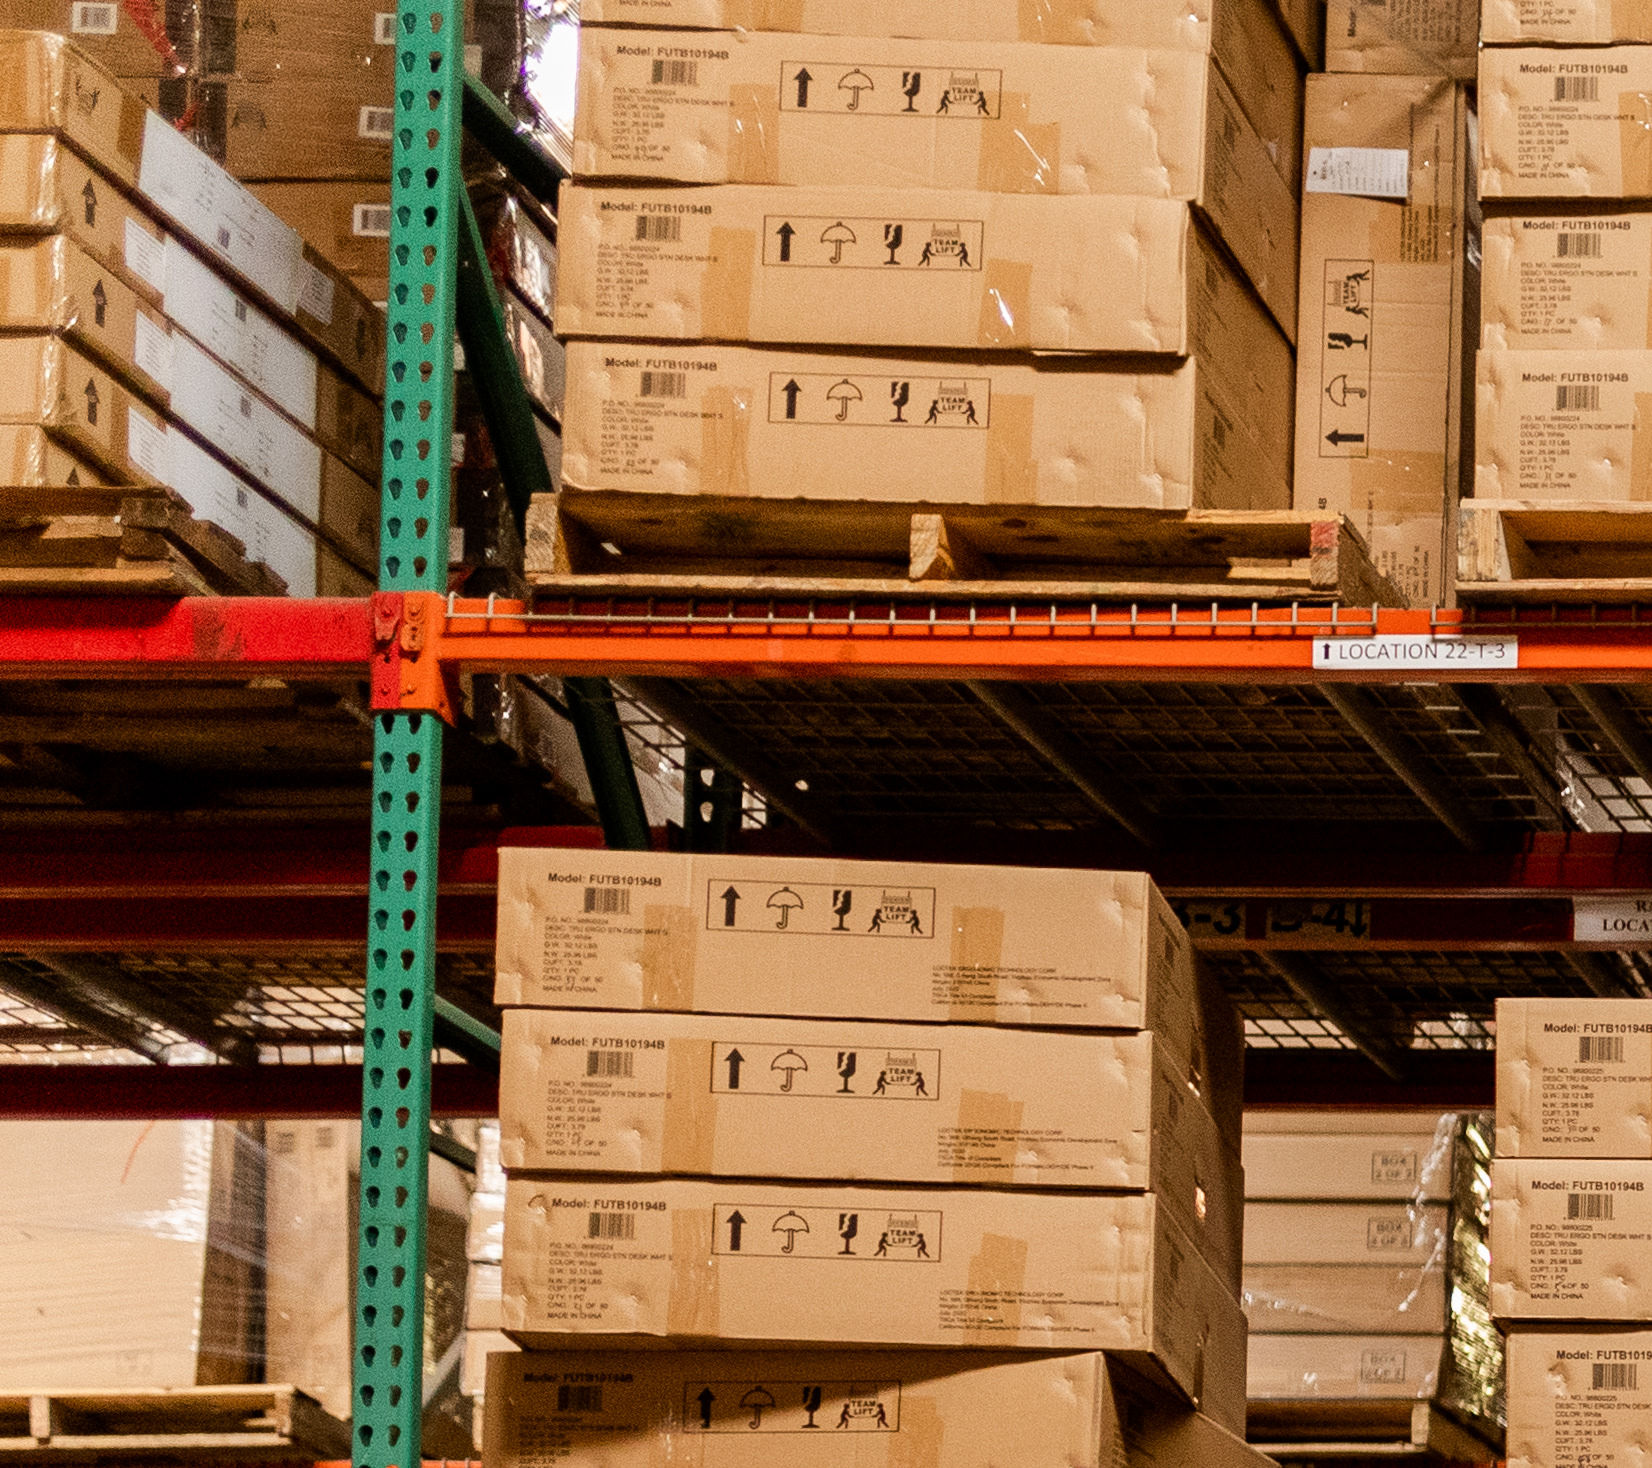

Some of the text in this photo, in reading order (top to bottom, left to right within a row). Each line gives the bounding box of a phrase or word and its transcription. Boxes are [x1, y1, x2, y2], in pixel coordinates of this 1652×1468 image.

[617, 45, 730, 59] Model: FUTB10194B
[1520, 63, 1629, 76] Model: FUTB10194B
[605, 357, 718, 371] Model: FUTB10194B
[1522, 372, 1629, 385] Model: FUTB10194B
[1339, 642, 1505, 660] LOCATION 22-T-3
[548, 872, 662, 886] Model: FUTB10194B
[1544, 1022, 1581, 1033] Model:
[550, 1036, 666, 1050] Model: FUTB10194B
[1532, 1180, 1645, 1193] Model: FUTB10194B
